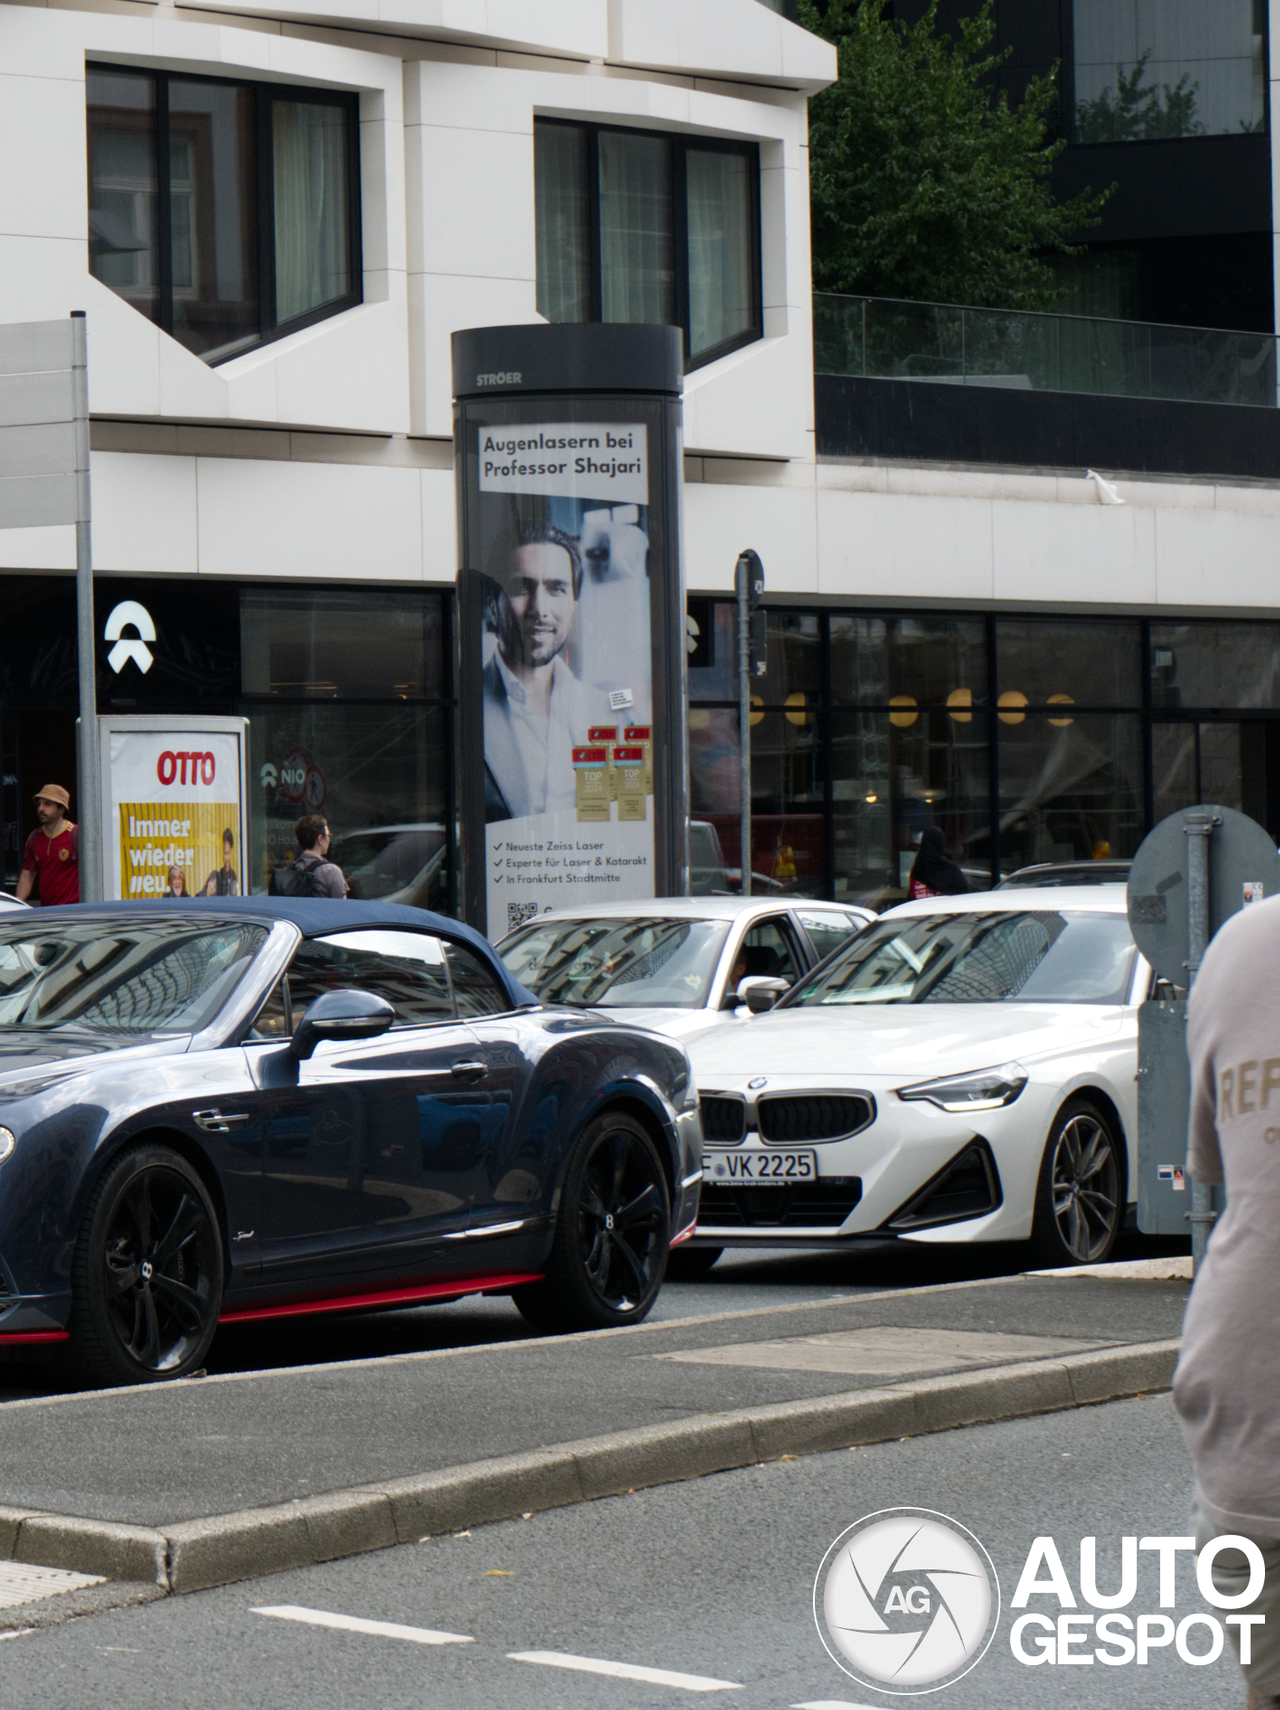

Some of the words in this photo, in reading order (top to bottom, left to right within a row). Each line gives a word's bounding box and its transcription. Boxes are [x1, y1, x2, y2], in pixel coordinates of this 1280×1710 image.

[476, 372, 522, 386] STRÖER
[483, 433, 600, 456] Augenlasern
[605, 432, 633, 449] bei
[484, 459, 567, 477] Professor
[574, 457, 642, 478] Shajari
[157, 750, 216, 786] OTTO
[280, 769, 305, 784] NIO
[583, 771, 603, 781] TOP
[623, 768, 640, 778] TOP
[129, 816, 191, 838] Immer
[129, 843, 194, 867] wieder
[506, 842, 544, 852] Neueste
[546, 841, 573, 851] Zeiss
[576, 841, 604, 850] Laser
[506, 858, 543, 869] Experte
[545, 857, 561, 868] für
[563, 857, 591, 867] Laser
[594, 857, 603, 866] &
[606, 855, 647, 866] Katarakt
[130, 874, 171, 894] neu.
[506, 874, 515, 884] In
[517, 874, 563, 884] Frankfurt
[566, 873, 621, 883] Stadtmitte
[726, 1155, 754, 1177] VK
[758, 1154, 811, 1177] 2225
